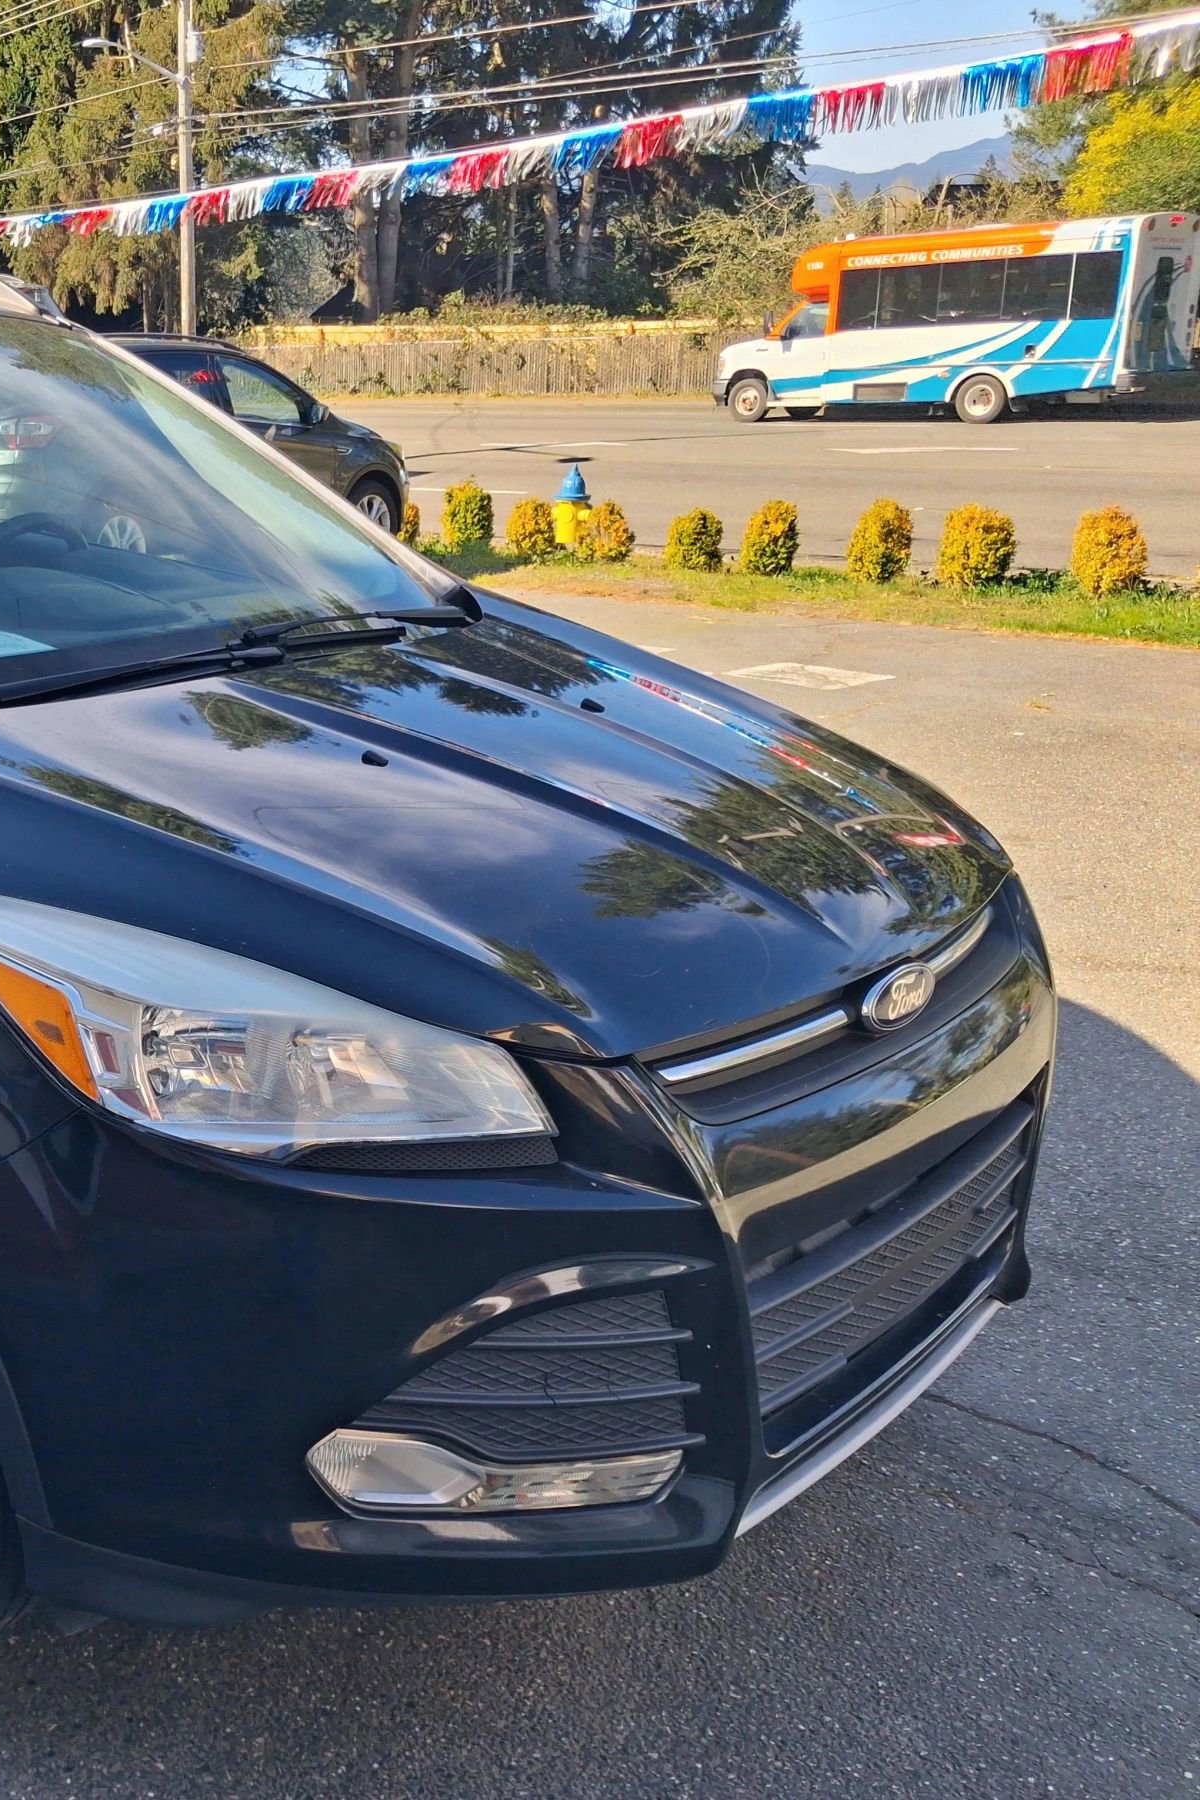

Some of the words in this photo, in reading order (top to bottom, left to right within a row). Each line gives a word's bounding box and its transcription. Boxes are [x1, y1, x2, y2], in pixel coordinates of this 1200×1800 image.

[847, 251, 927, 267] CONNECTING
[931, 244, 1024, 261] COMMUNITIES
[888, 971, 925, 1020] Ford
